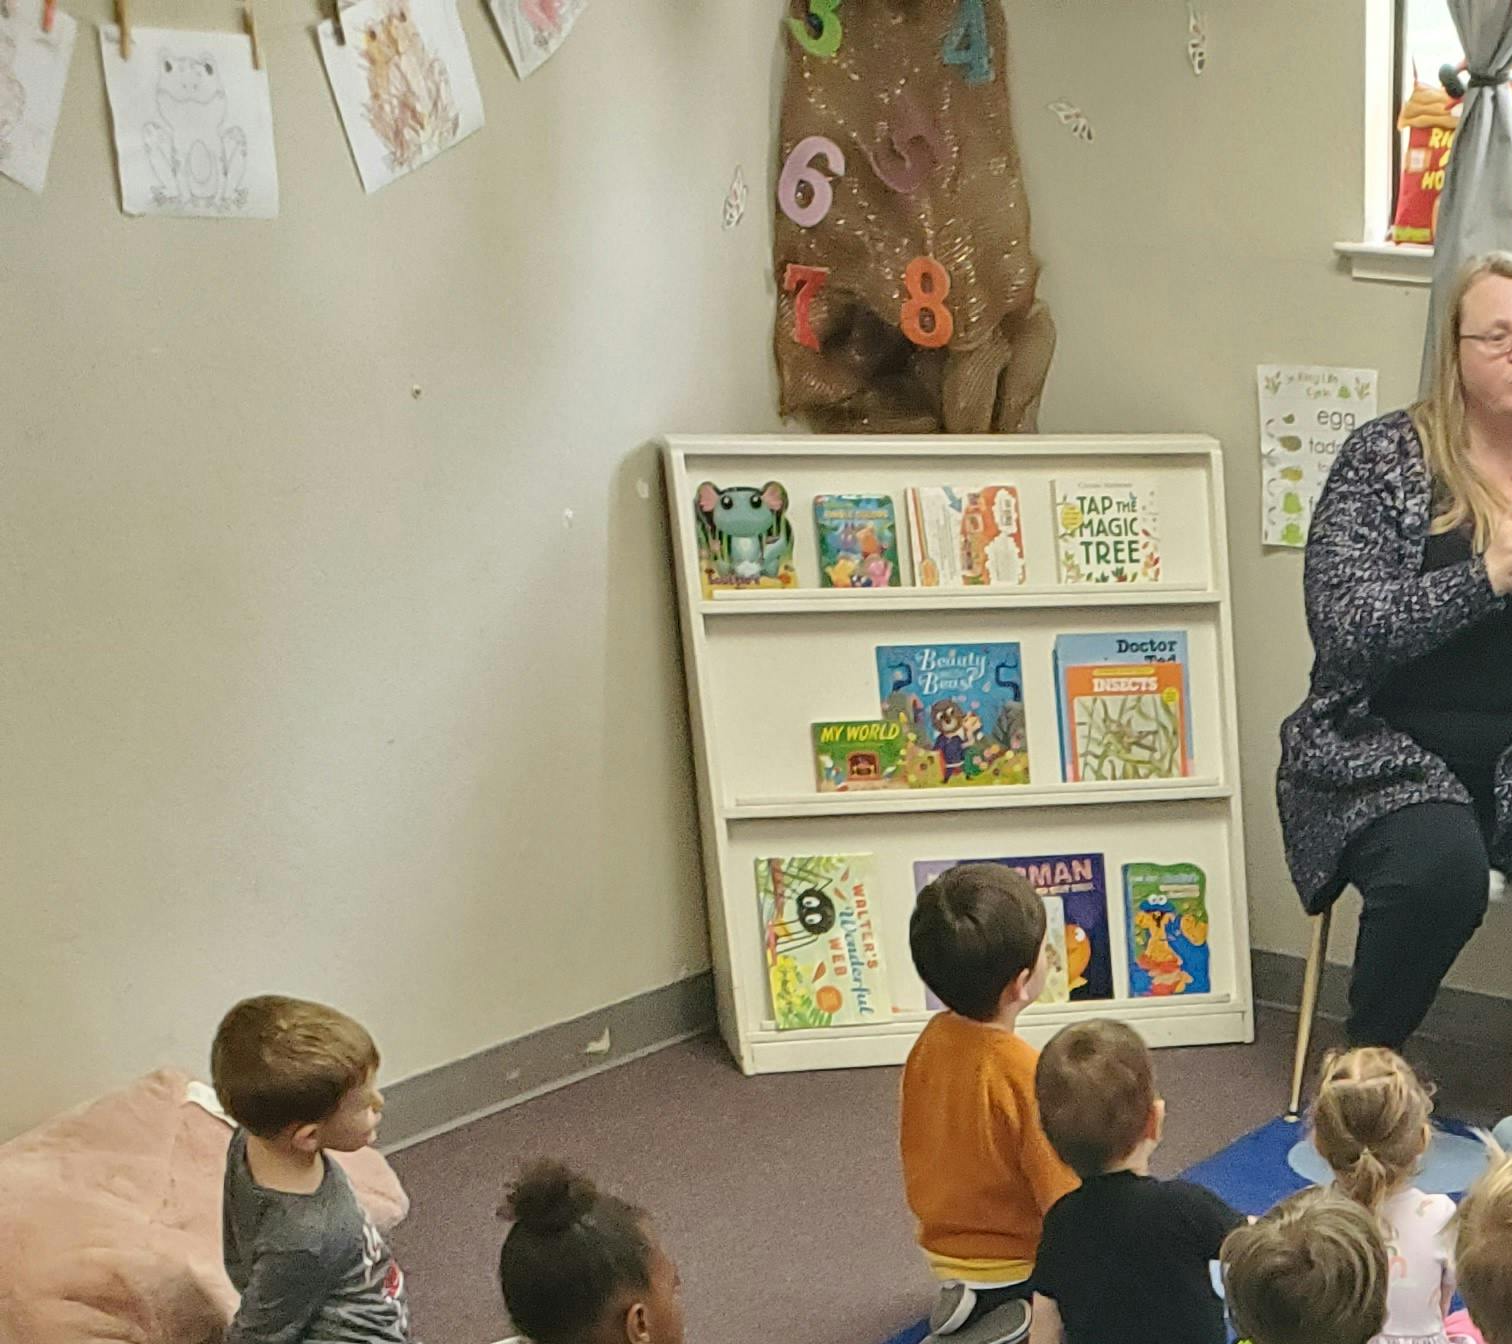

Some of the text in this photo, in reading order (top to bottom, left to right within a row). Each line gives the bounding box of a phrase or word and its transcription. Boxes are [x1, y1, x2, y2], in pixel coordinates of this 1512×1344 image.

[942, 0, 996, 86] 4
[778, 136, 845, 227] 6
[784, 256, 954, 350] 7 8
[1316, 410, 1356, 431] egg
[1076, 496, 1138, 516] TAP THE
[1078, 517, 1139, 538] MAGIC
[1080, 540, 1141, 565] TREE
[1116, 638, 1178, 653] Doctor
[915, 649, 988, 681] Beauty
[919, 669, 976, 695] Beast
[1092, 677, 1159, 693] INSECTS
[820, 723, 900, 743] MY WORLD
[1015, 858, 1094, 886] MAN
[852, 883, 879, 969] WALTER'S
[827, 936, 848, 976] WEB
[838, 906, 876, 1015] Wonderful
